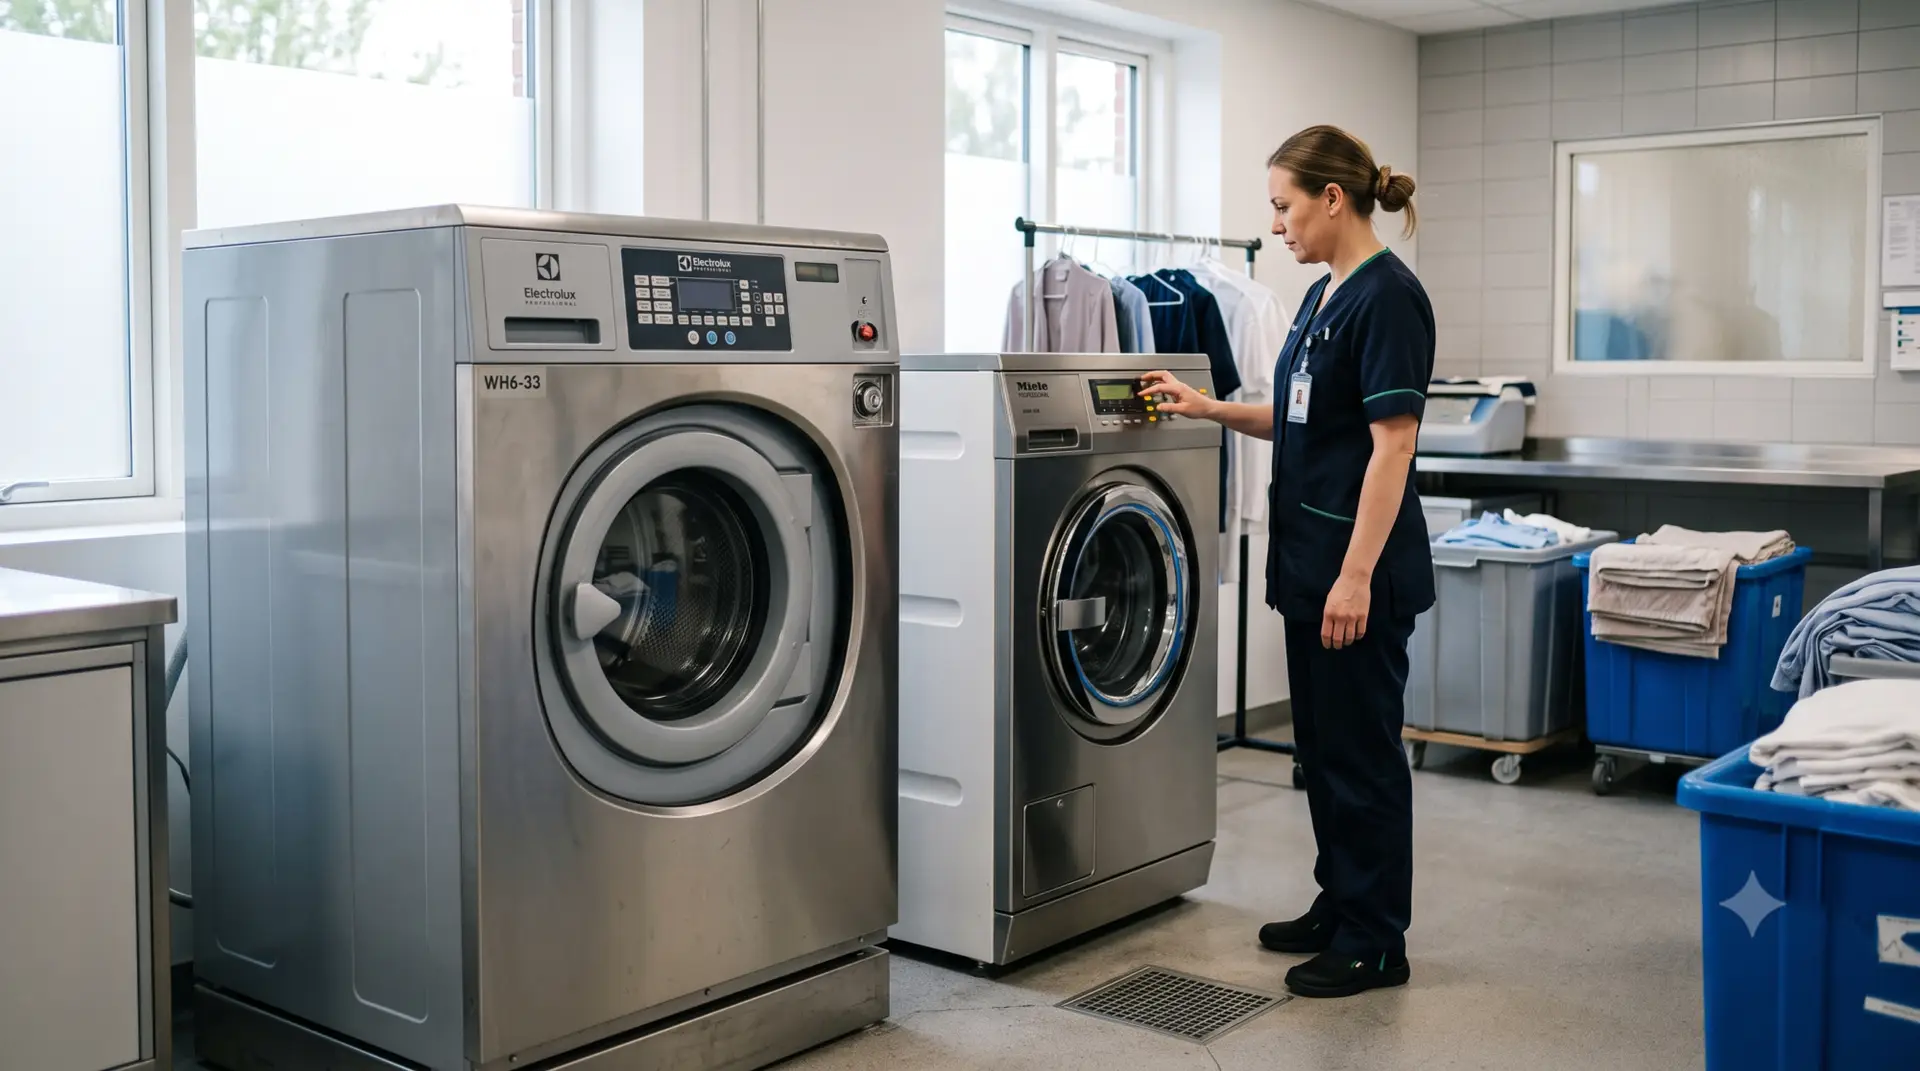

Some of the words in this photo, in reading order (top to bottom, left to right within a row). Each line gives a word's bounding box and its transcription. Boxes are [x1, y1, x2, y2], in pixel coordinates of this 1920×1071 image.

[692, 257, 731, 268] Electrolux
[524, 287, 577, 300] Electrolux
[484, 374, 541, 390] WH6-33
[1016, 381, 1049, 391] Miele
